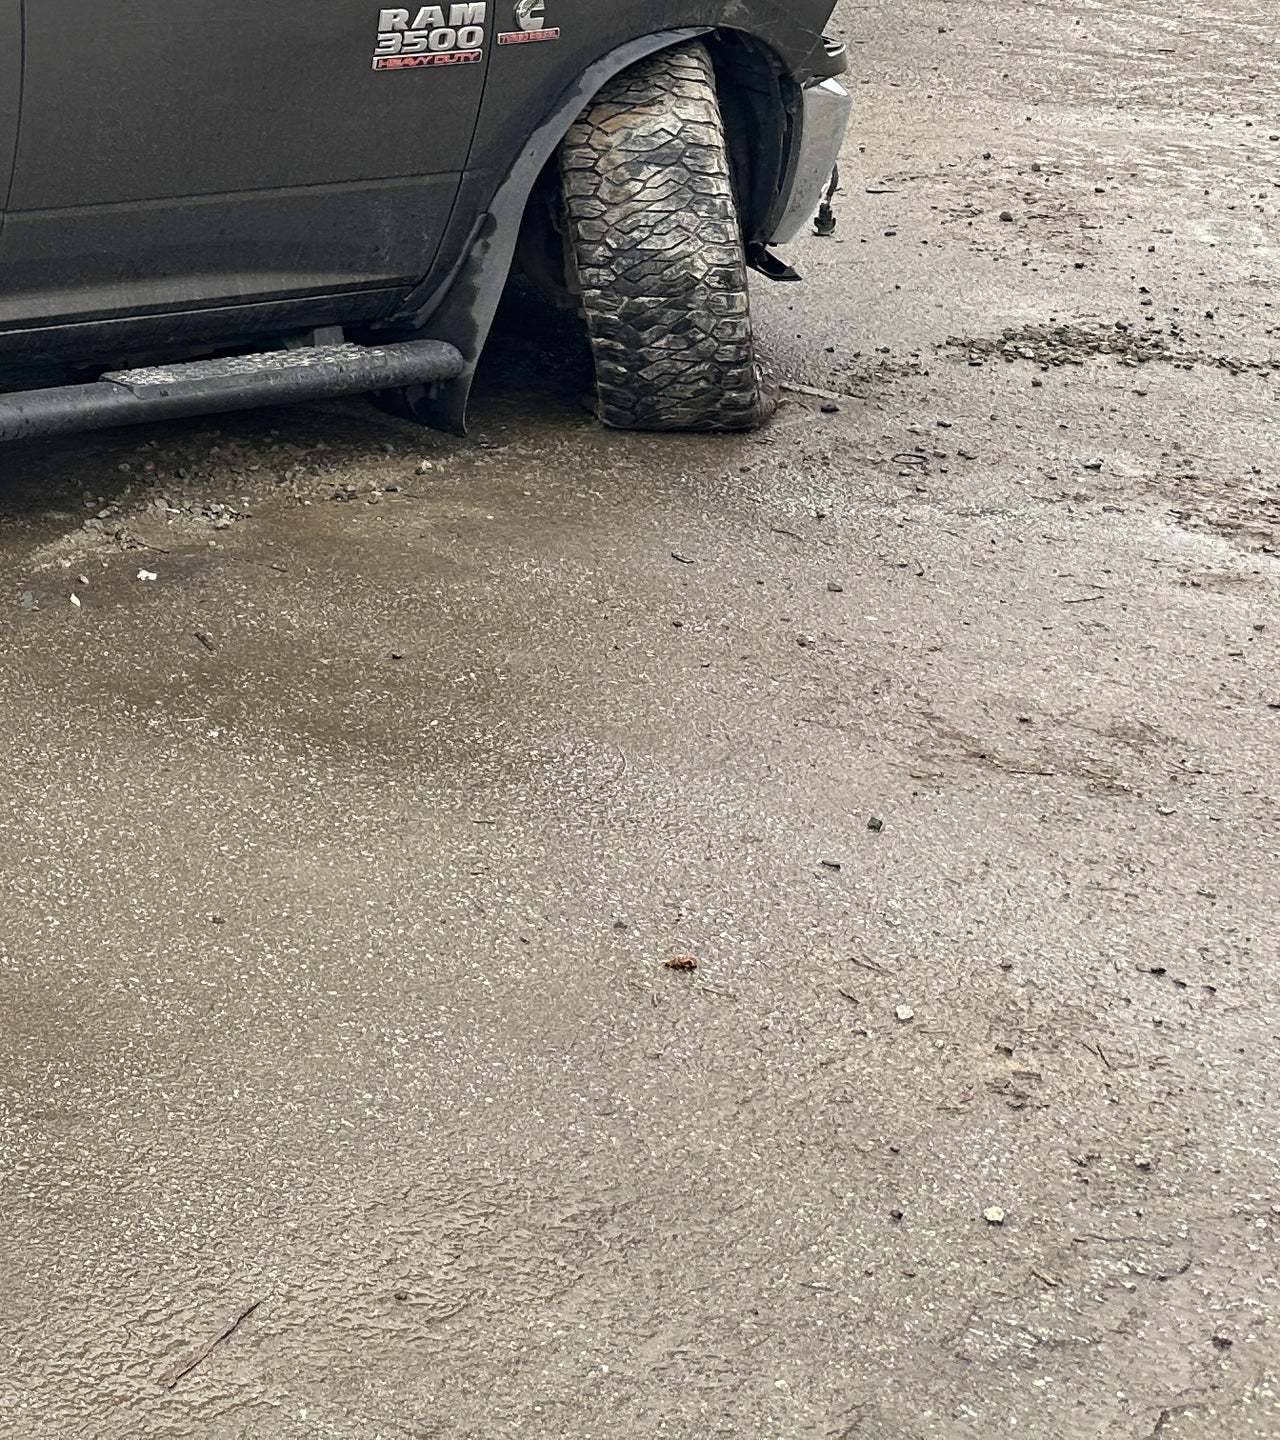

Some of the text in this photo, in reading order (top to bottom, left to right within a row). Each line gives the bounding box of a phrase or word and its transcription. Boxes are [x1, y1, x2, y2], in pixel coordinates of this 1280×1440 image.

[377, 1, 487, 32] RAM
[374, 25, 485, 55] 3500
[377, 51, 480, 68] HEAVY DUTY
